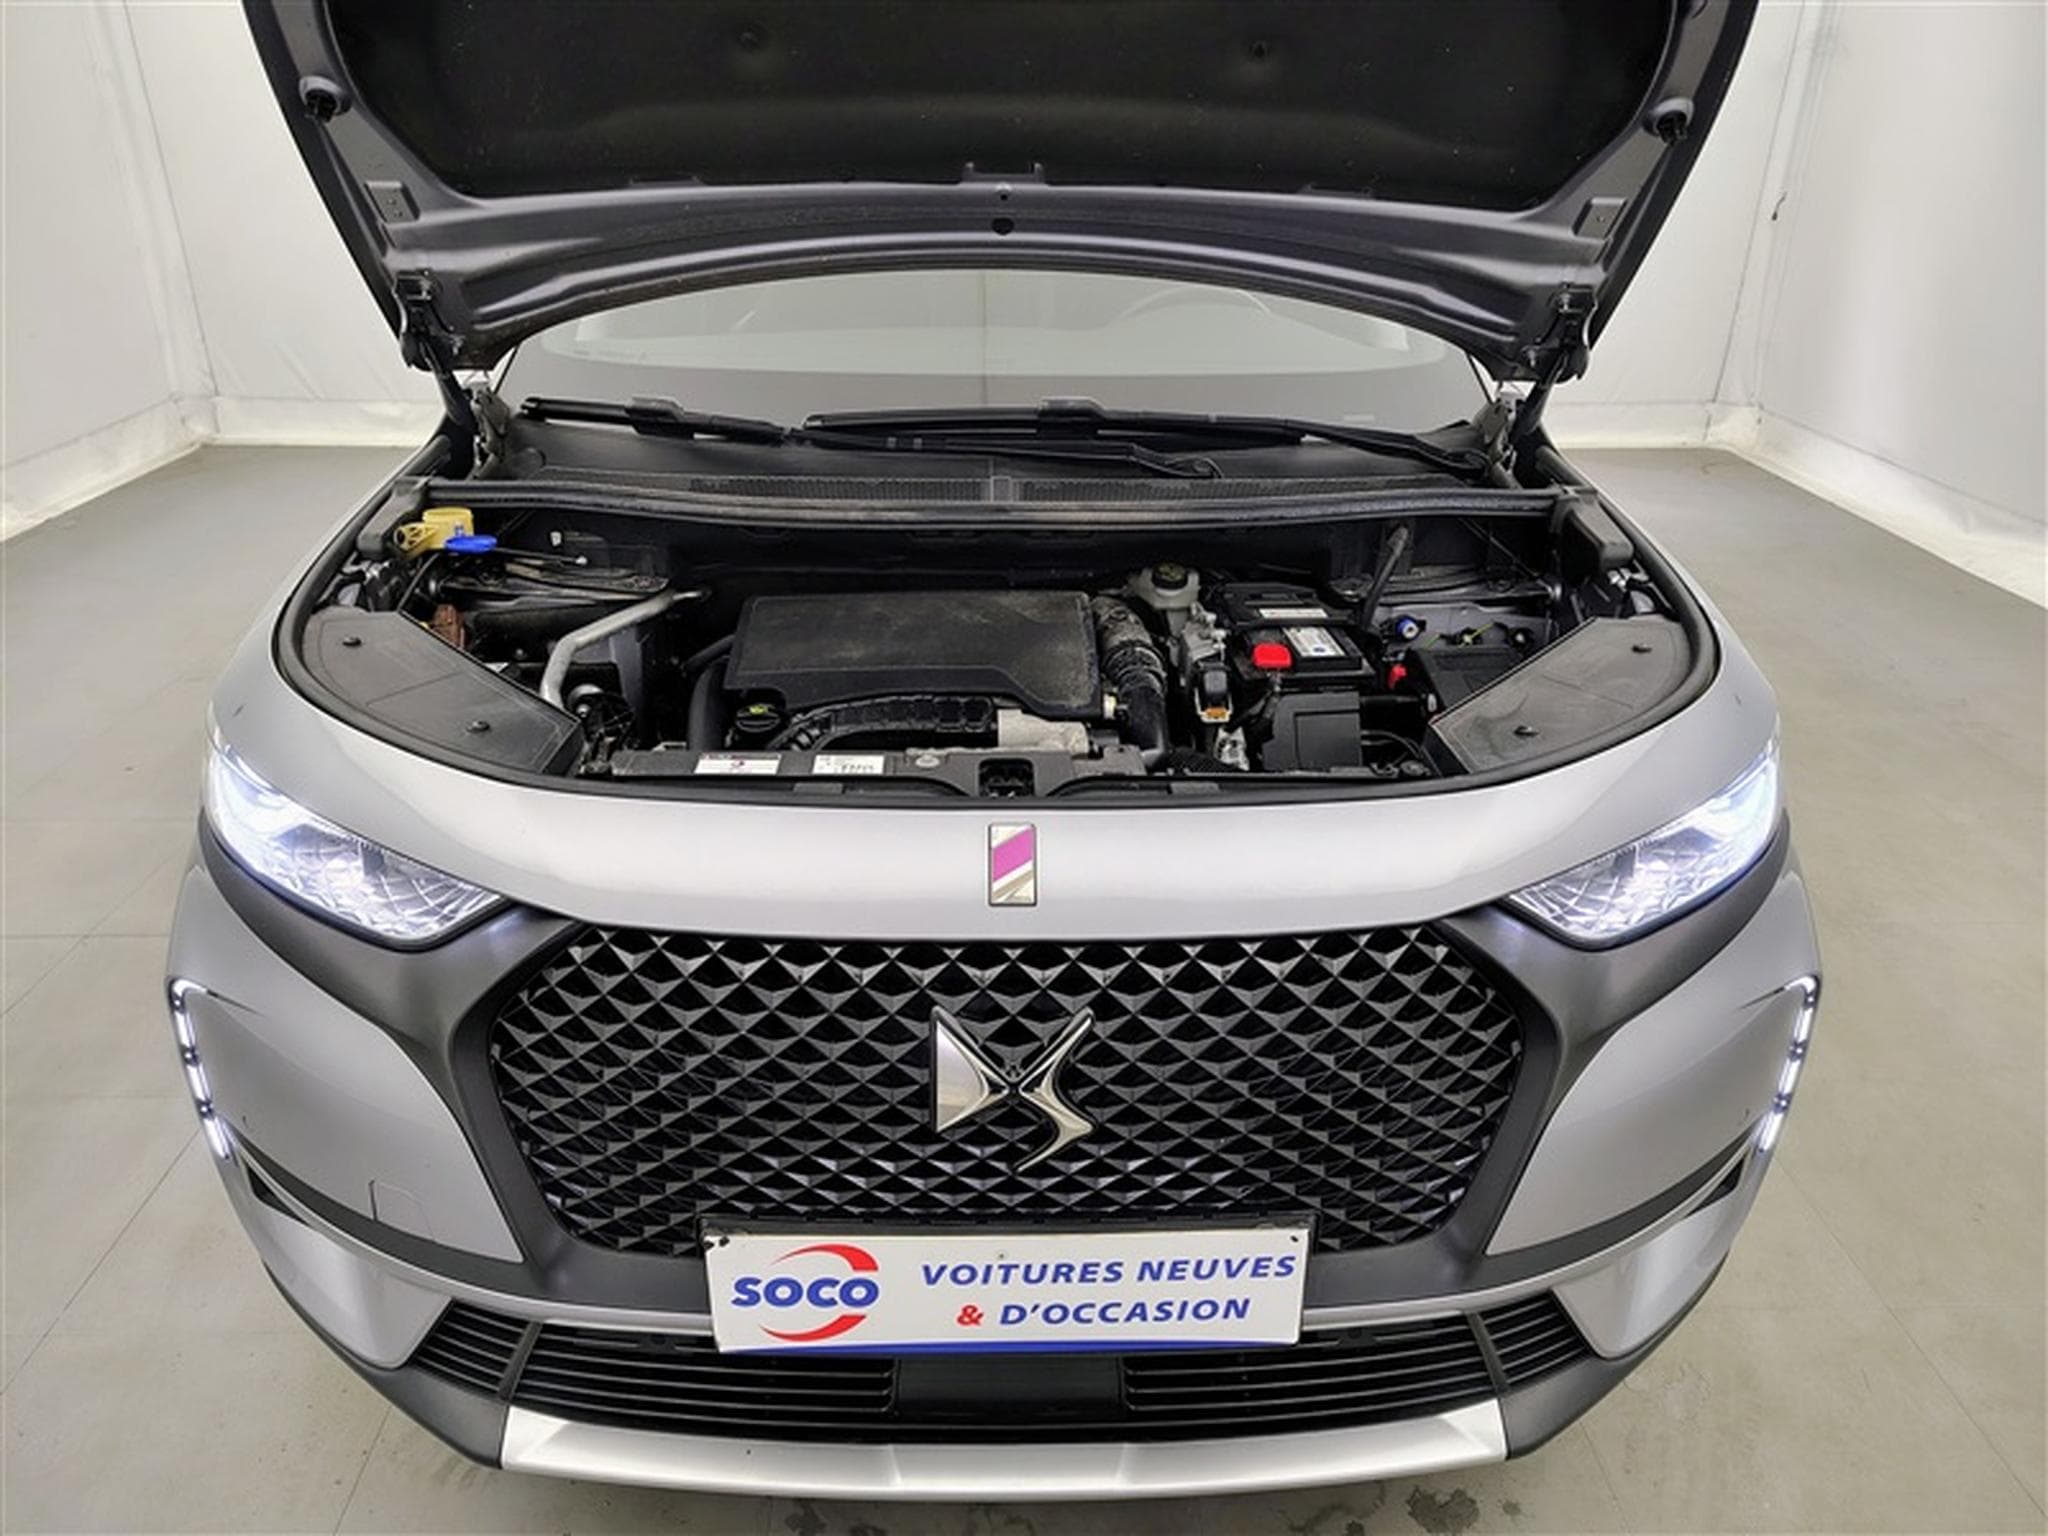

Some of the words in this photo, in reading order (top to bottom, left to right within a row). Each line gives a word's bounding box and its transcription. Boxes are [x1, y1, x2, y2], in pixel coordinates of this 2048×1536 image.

[921, 1260, 1124, 1286] VOITURES
[1137, 1255, 1297, 1282] NEUVES
[731, 1276, 880, 1308] SOCO
[956, 1304, 983, 1327] &
[999, 1297, 1252, 1326] D'OCCASION
